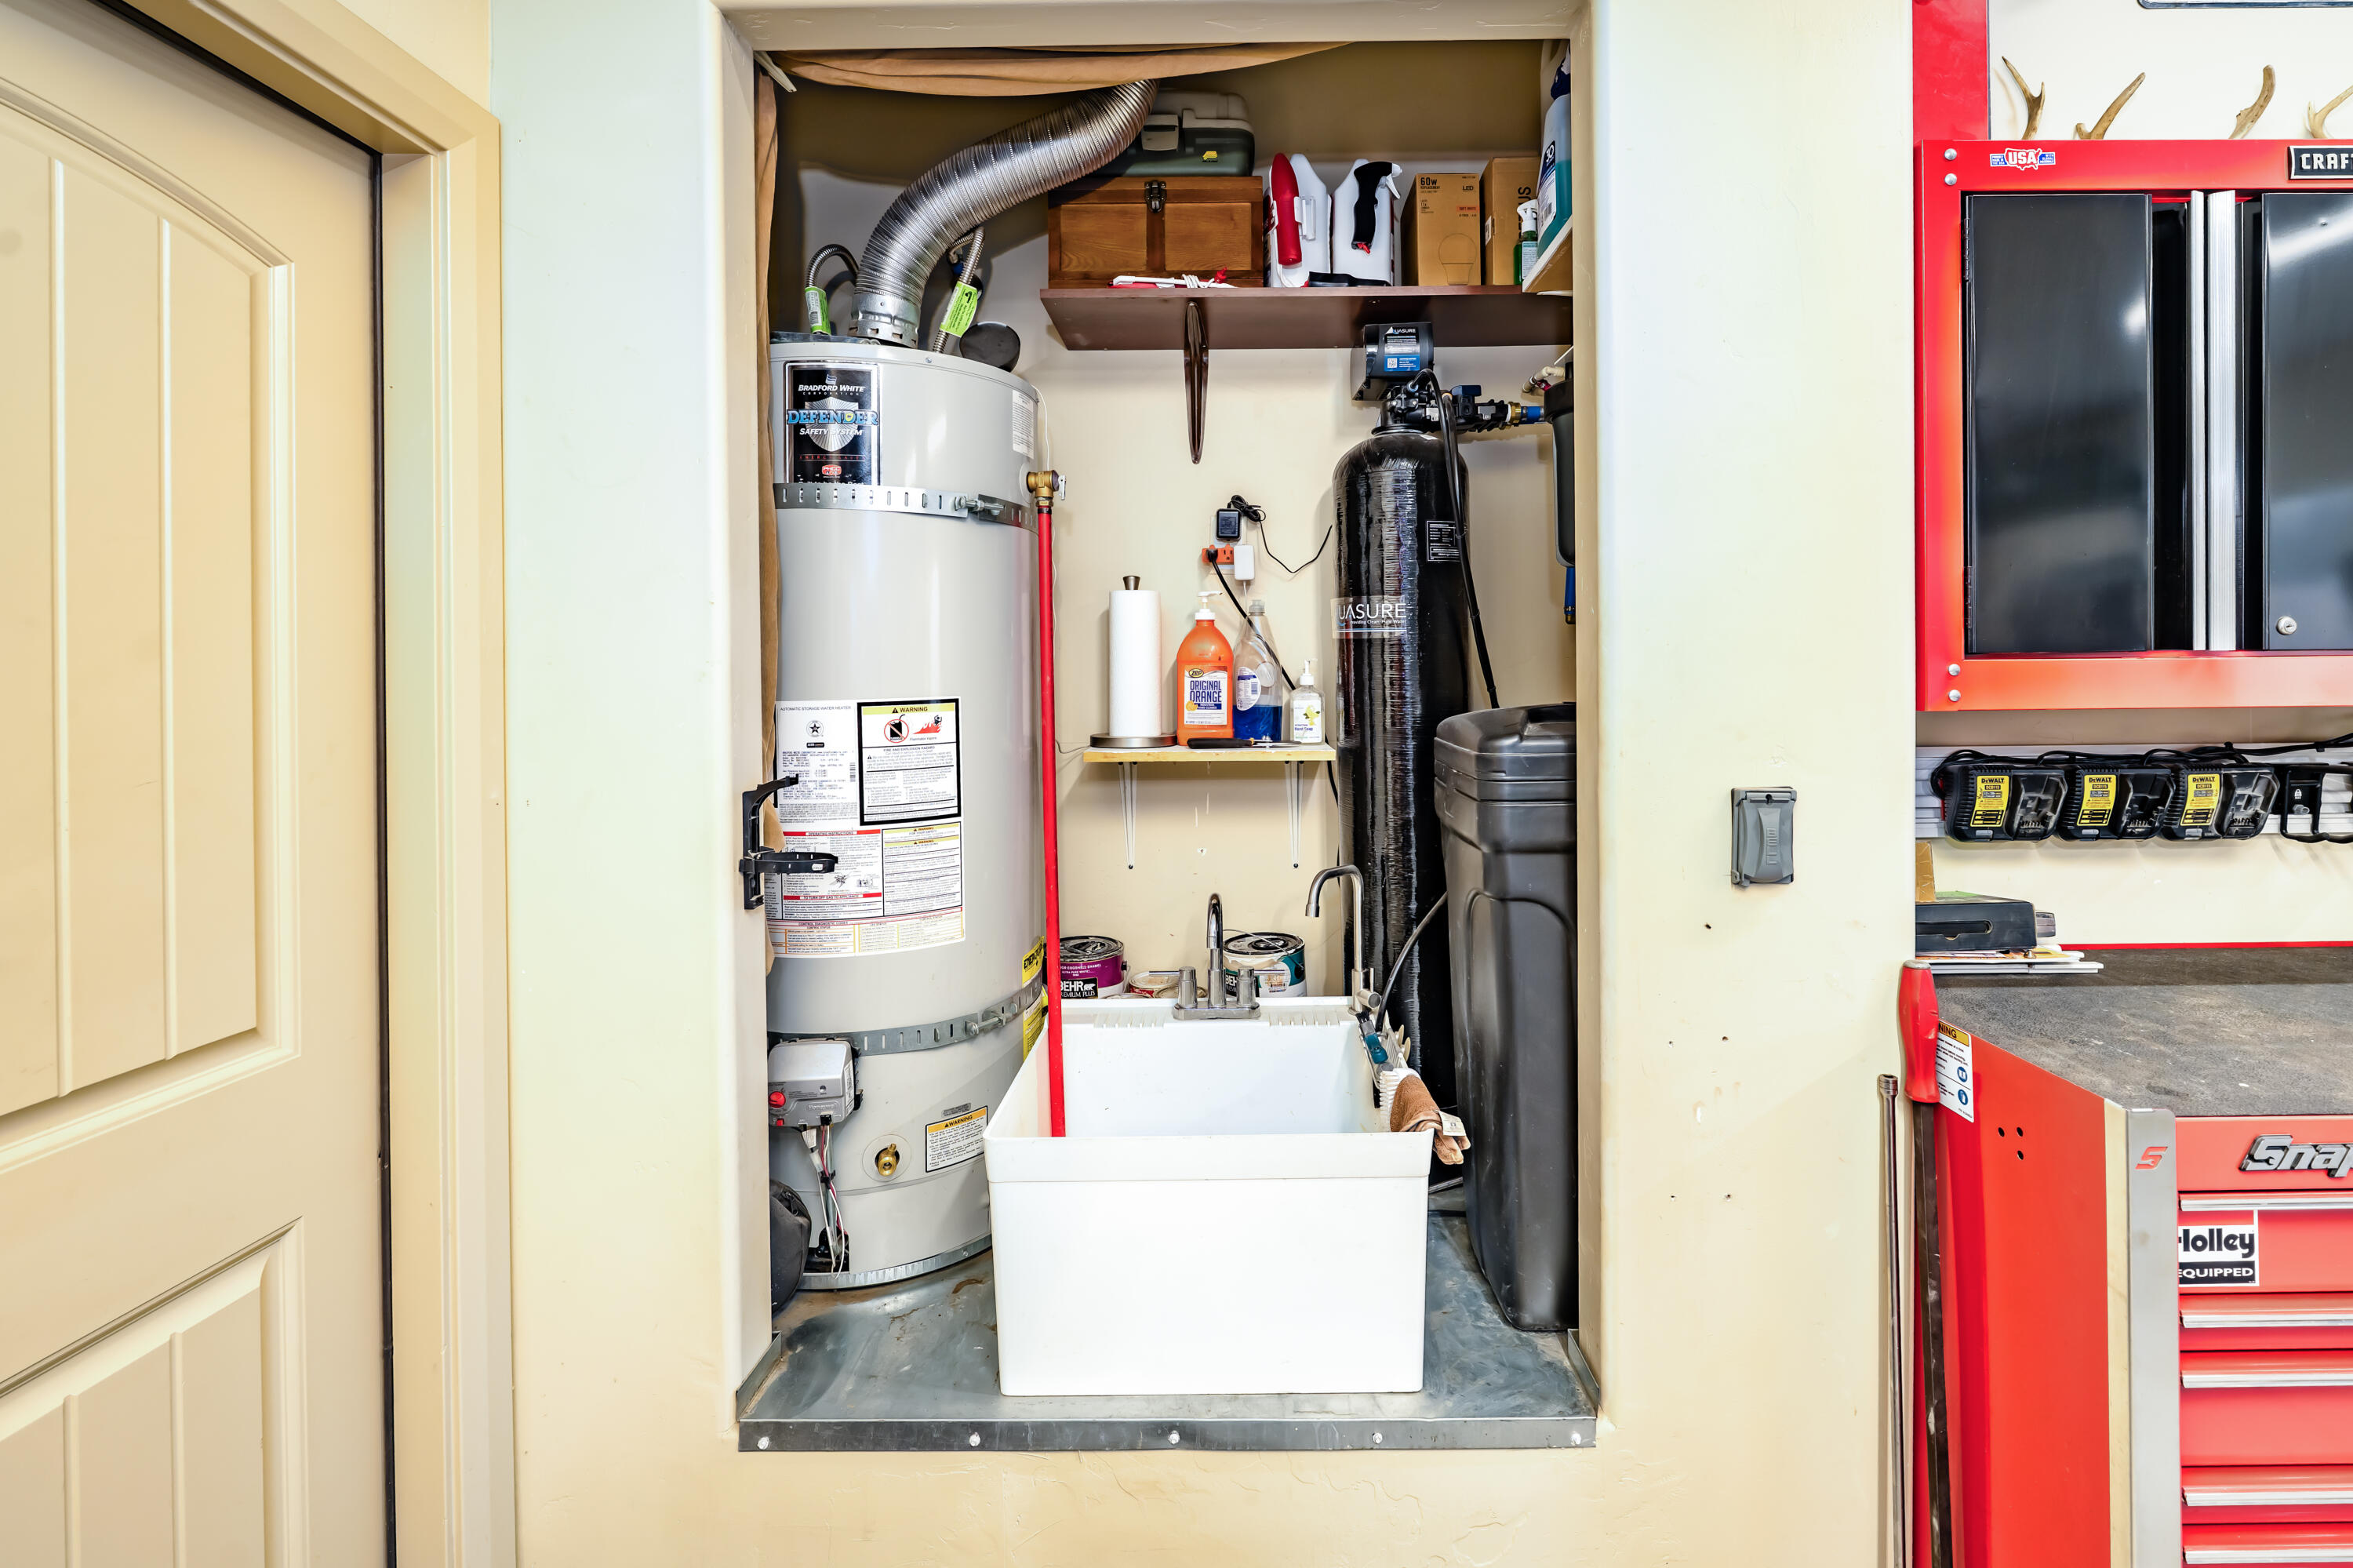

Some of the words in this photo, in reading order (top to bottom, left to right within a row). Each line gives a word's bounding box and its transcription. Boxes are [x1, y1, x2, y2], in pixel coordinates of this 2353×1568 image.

[2008, 151, 2037, 165] USA
[2301, 153, 2353, 169] CRAF
[787, 409, 878, 425] DEFENDER
[1339, 603, 1407, 620] UASURE
[1190, 680, 1221, 690] ORIGINAL
[1190, 691, 1222, 702] ORANGE
[1060, 981, 1084, 991] BEHR
[1939, 1022, 1957, 1039] NING
[948, 1115, 973, 1126] WARNING
